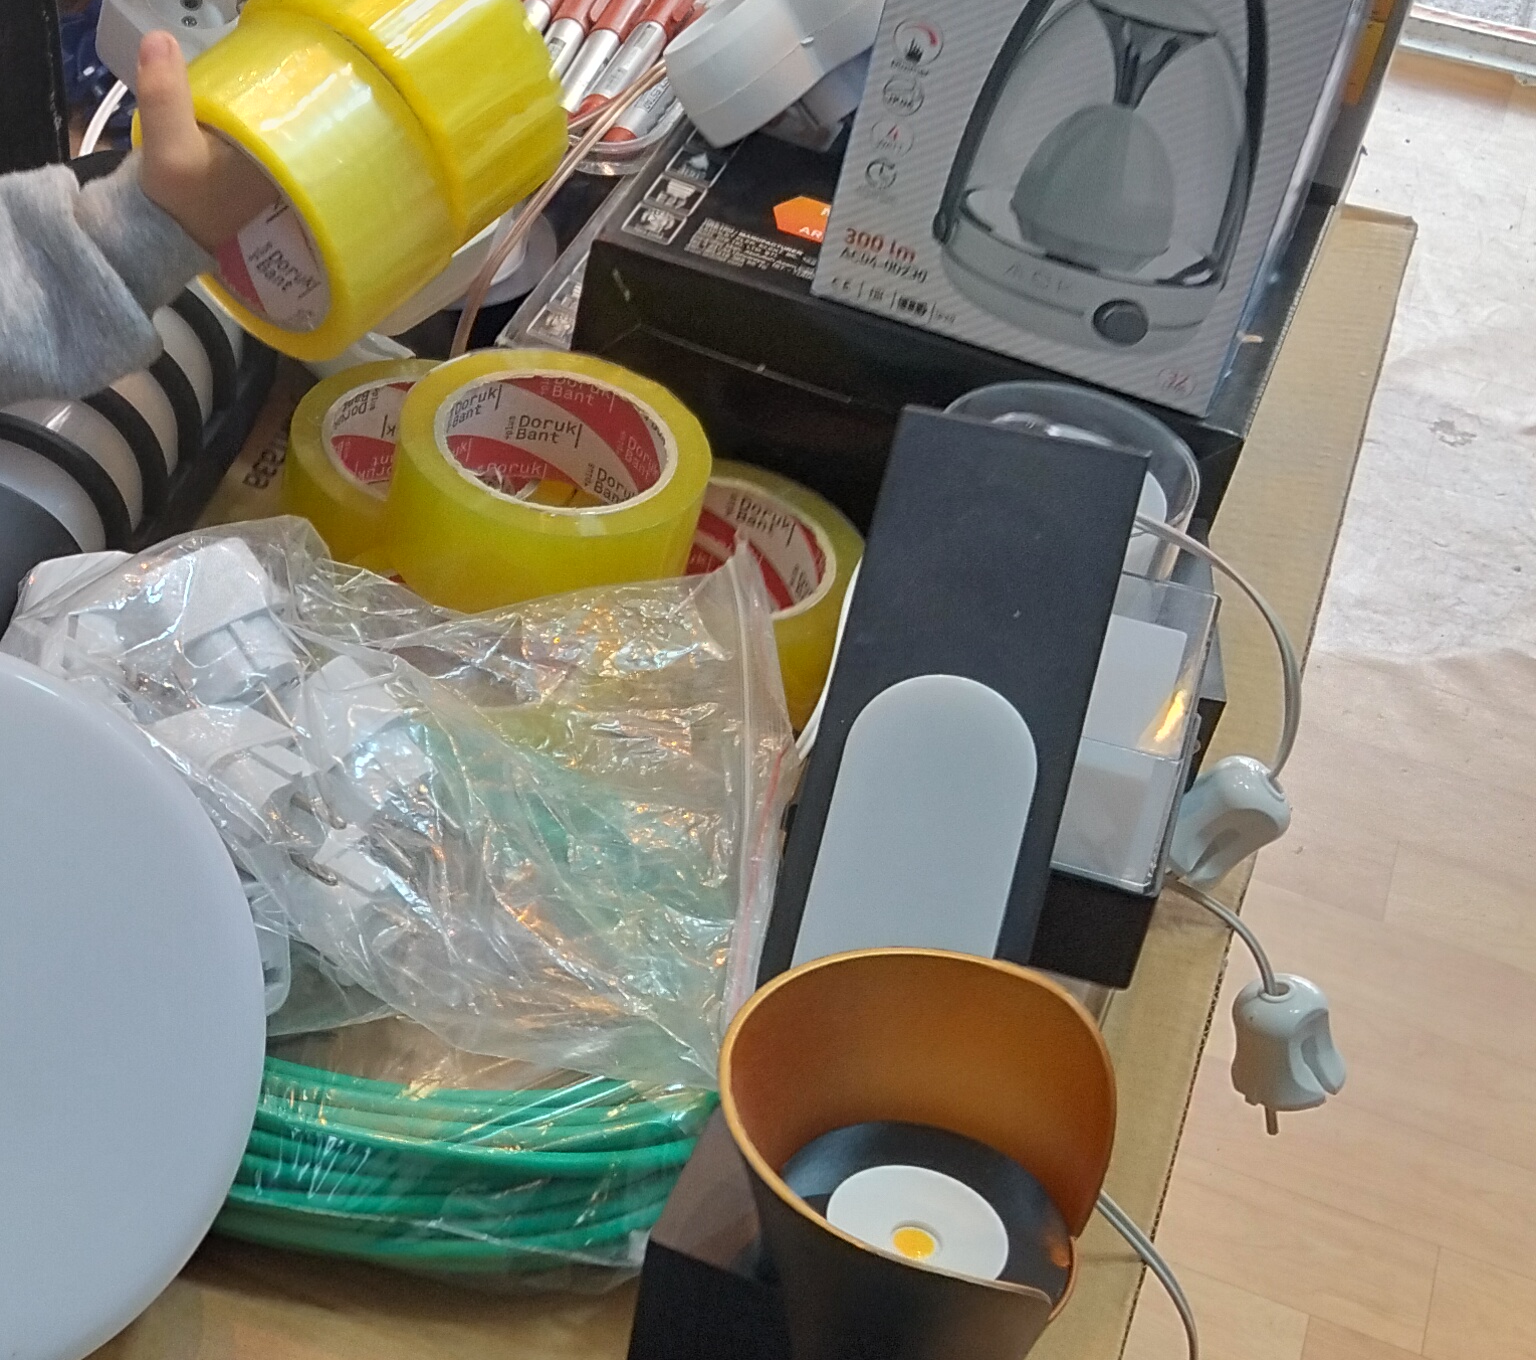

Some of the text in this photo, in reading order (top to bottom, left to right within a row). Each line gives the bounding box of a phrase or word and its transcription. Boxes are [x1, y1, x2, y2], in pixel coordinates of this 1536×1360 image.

[846, 228, 916, 263] 300 lm
[552, 387, 595, 407] Bant
[519, 414, 578, 437] Doruk
[516, 429, 560, 445] Bant
[372, 455, 394, 467] nt
[593, 482, 621, 504] Ban
[598, 466, 635, 498] Doru
